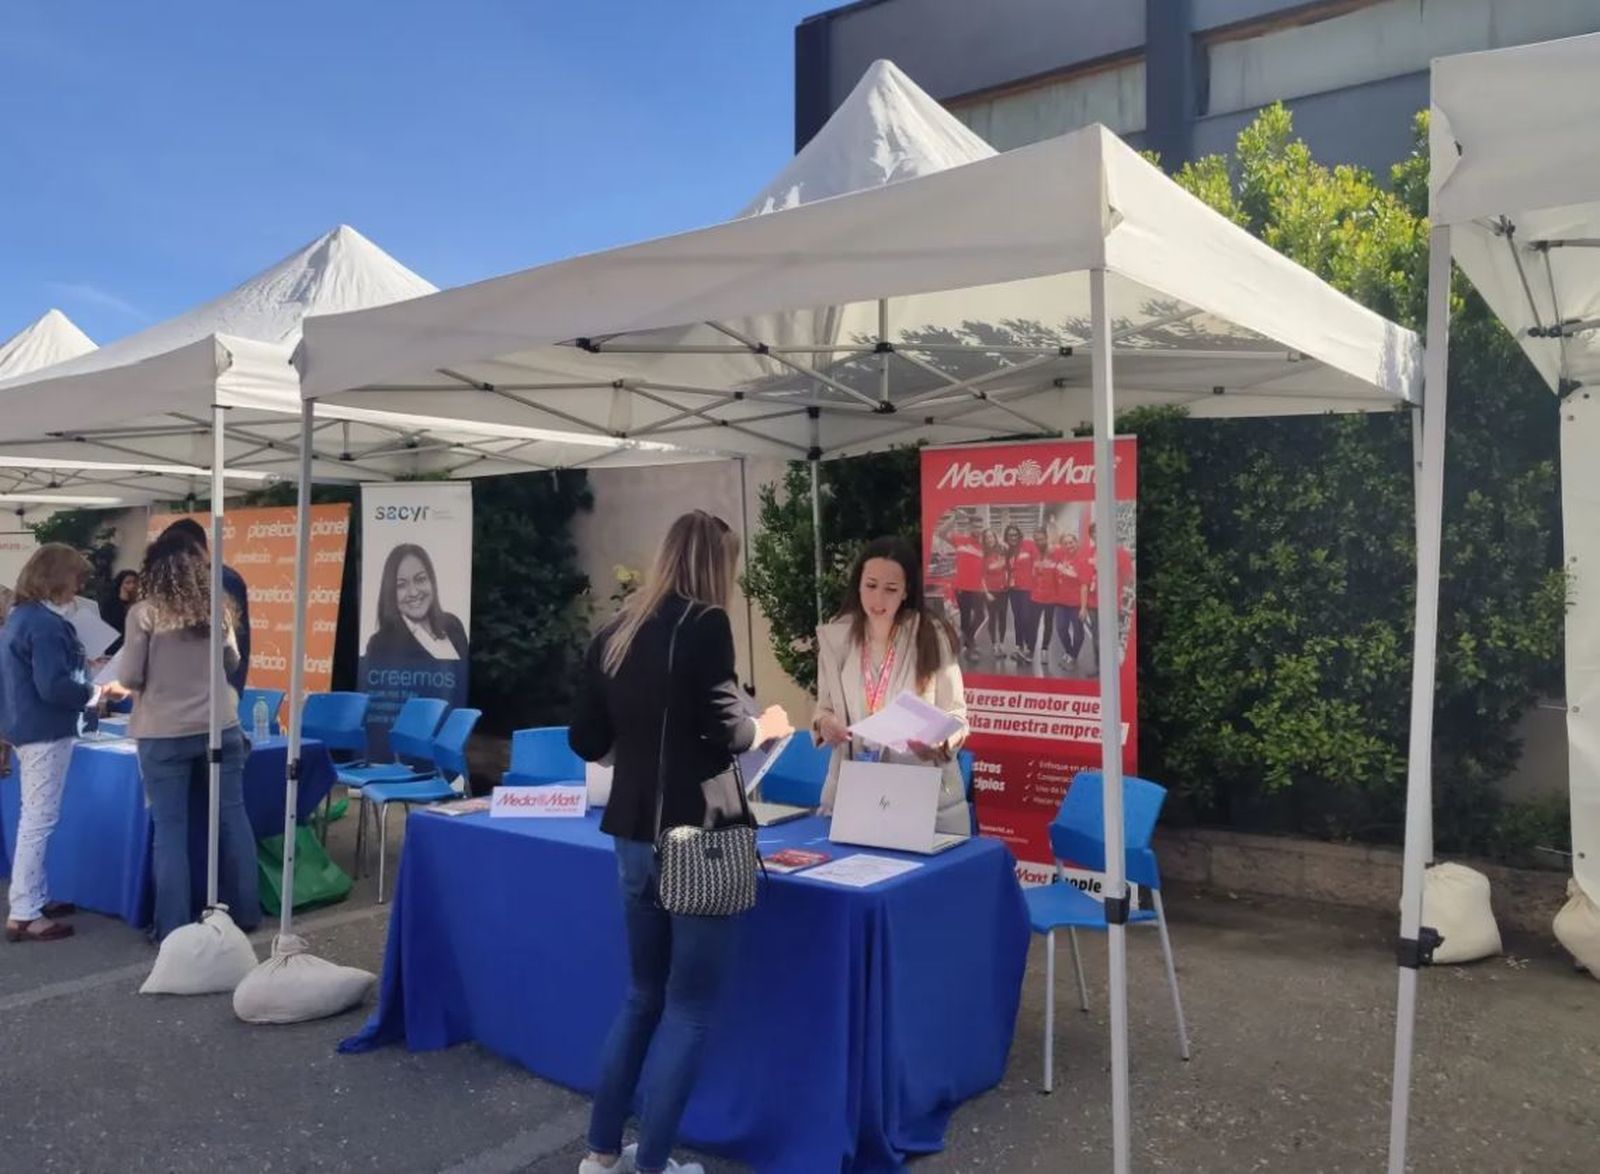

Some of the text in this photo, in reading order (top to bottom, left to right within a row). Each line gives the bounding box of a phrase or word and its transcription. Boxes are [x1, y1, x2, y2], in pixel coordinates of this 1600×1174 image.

[937, 456, 1097, 489] Media Mar
[375, 505, 430, 522] sacyr
[368, 669, 455, 689] creemos
[977, 694, 1006, 708] eres
[1008, 694, 1021, 708] el
[1024, 696, 1070, 711] motor
[1071, 700, 1100, 715] que
[993, 717, 1048, 733] nuestra
[1051, 723, 1102, 739] empre
[972, 761, 1002, 774] stros
[497, 793, 537, 807] Media
[1052, 873, 1102, 893] Pople
